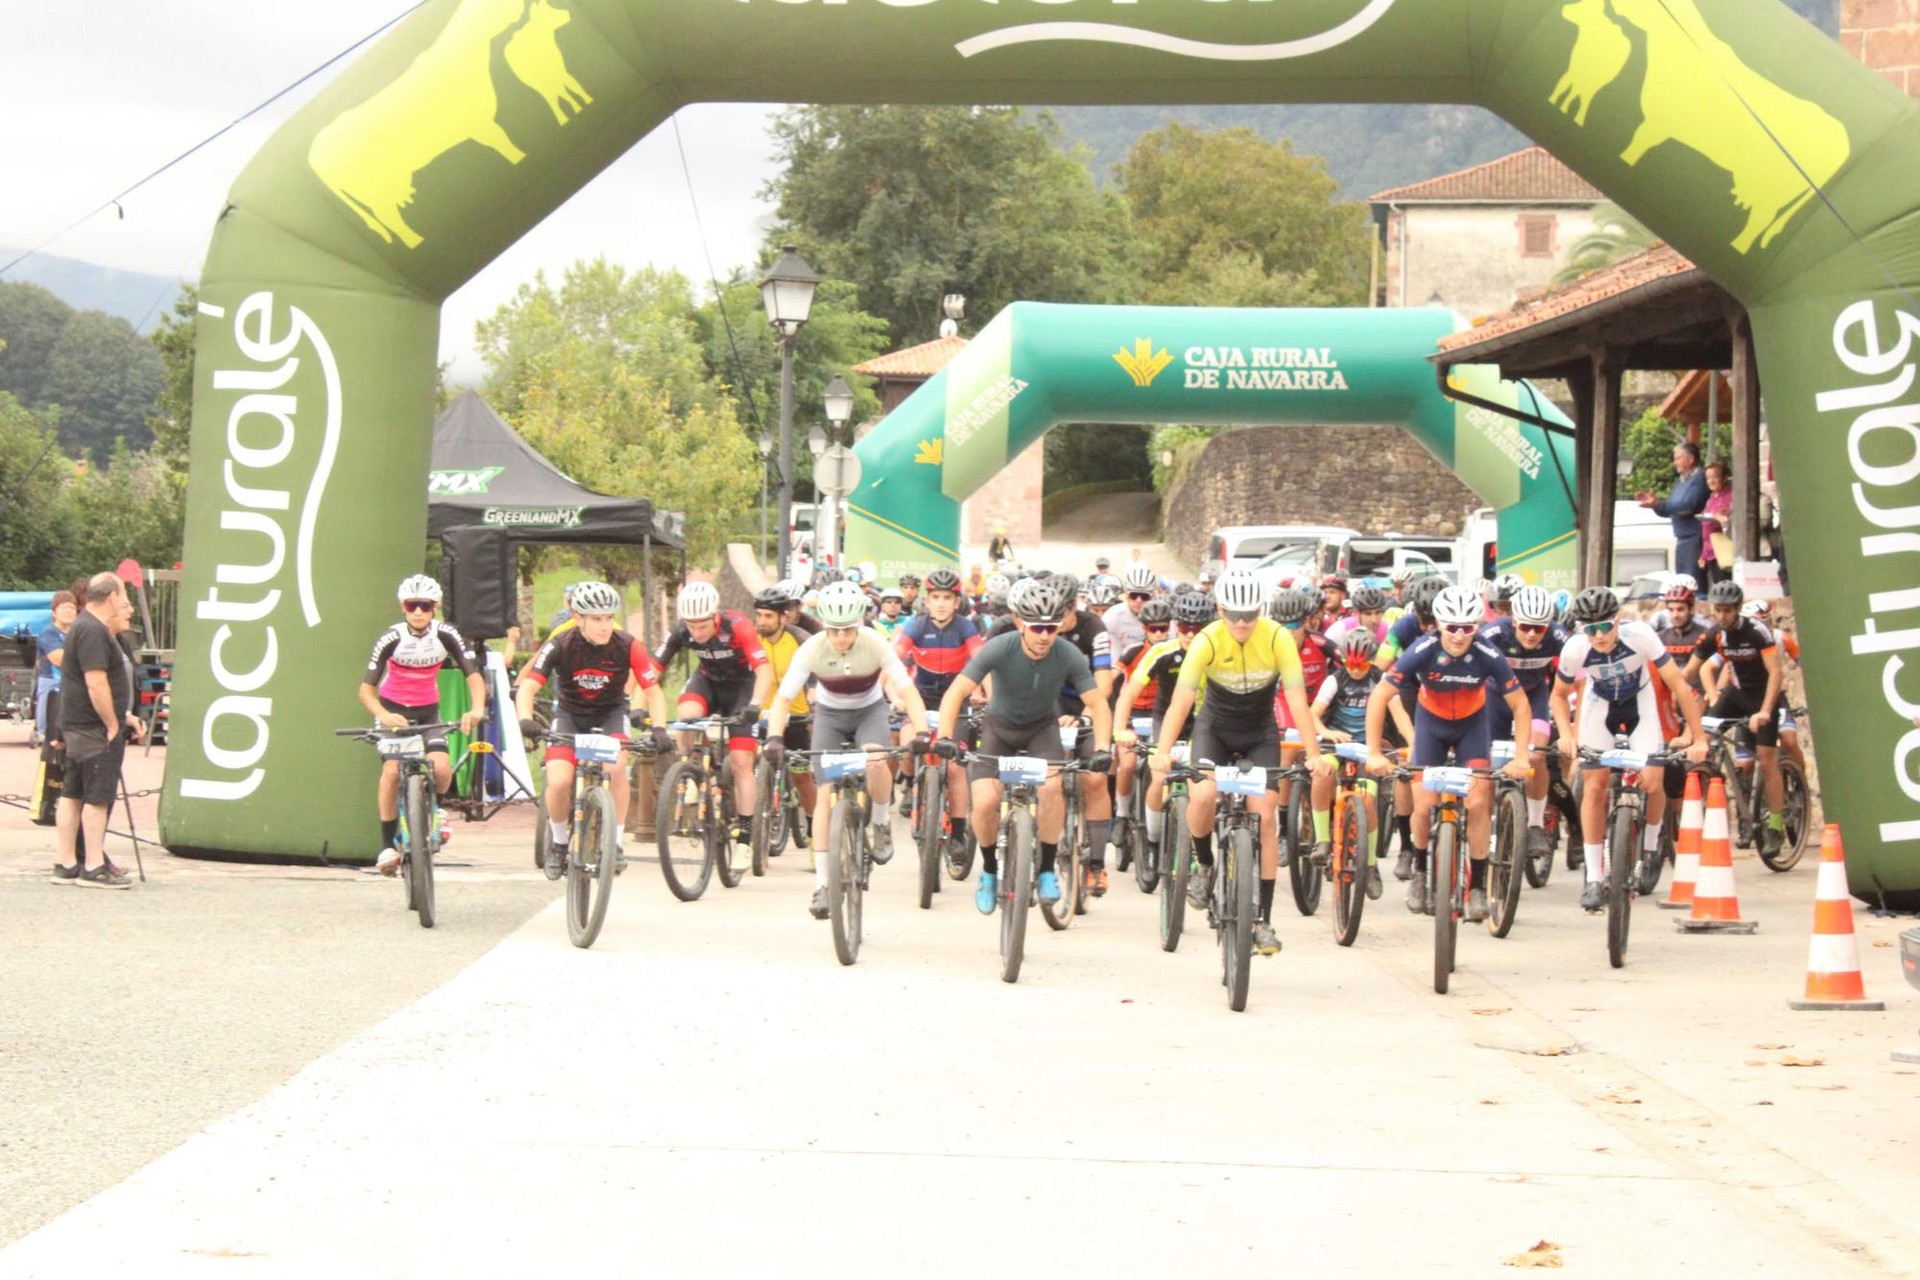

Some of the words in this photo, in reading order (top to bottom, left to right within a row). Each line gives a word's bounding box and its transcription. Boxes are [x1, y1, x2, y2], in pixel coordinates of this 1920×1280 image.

[1184, 346, 1248, 368] CAJA
[1251, 347, 1338, 368] RURAL
[1184, 369, 1220, 389] DE
[1227, 370, 1349, 390] NAVARRA
[387, 743, 402, 753] 73
